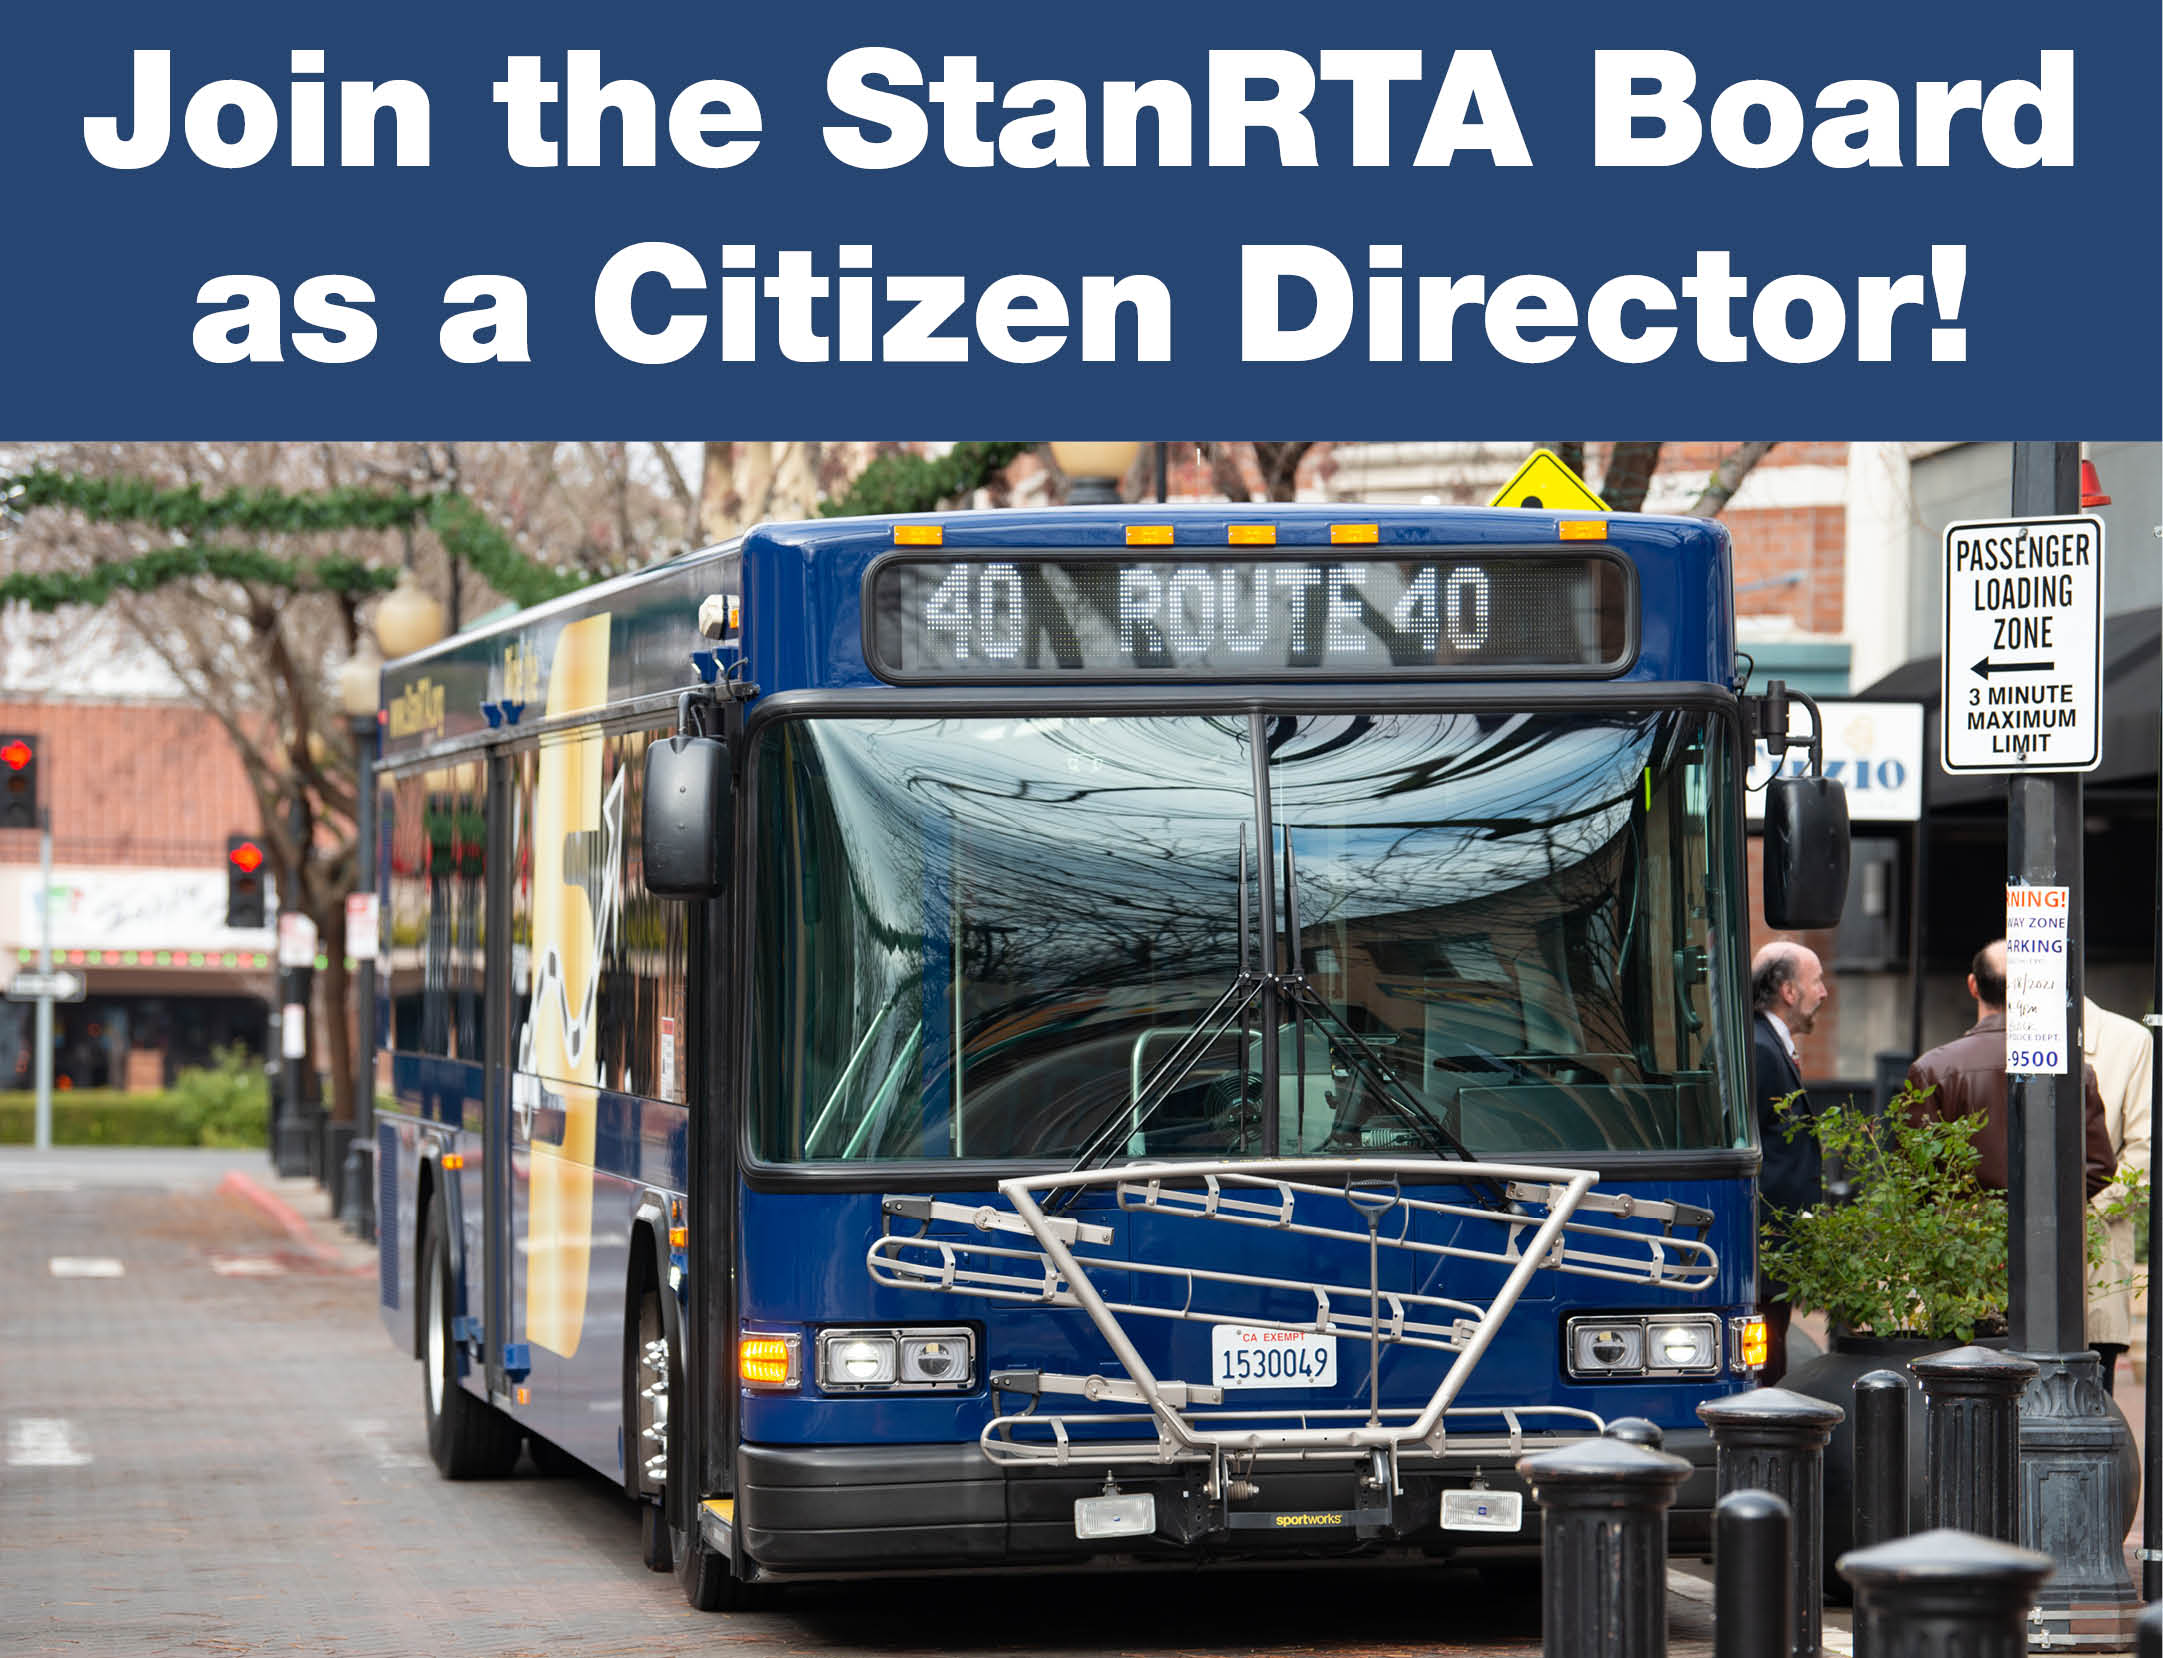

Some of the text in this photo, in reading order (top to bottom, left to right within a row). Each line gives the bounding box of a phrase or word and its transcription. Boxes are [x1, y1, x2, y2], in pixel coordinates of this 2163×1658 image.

[1957, 534, 2089, 572] PASSENGER
[1975, 574, 2072, 611] LOADING
[925, 562, 1490, 659] 40 ROUTE 40
[1993, 616, 2053, 650] ZONE
[1969, 685, 2073, 706] 3 MINUTE
[1967, 709, 2076, 730] MAXIMUM
[1992, 733, 2051, 753] LIMIT
[2028, 917, 2065, 929] ZONE
[2007, 939, 2063, 954] ARKING
[2008, 1050, 2058, 1067] -9500
[1242, 1331, 1305, 1343] CA EXEMPT
[1222, 1347, 1328, 1379] 1530049
[1275, 1513, 1342, 1528] sportworks
